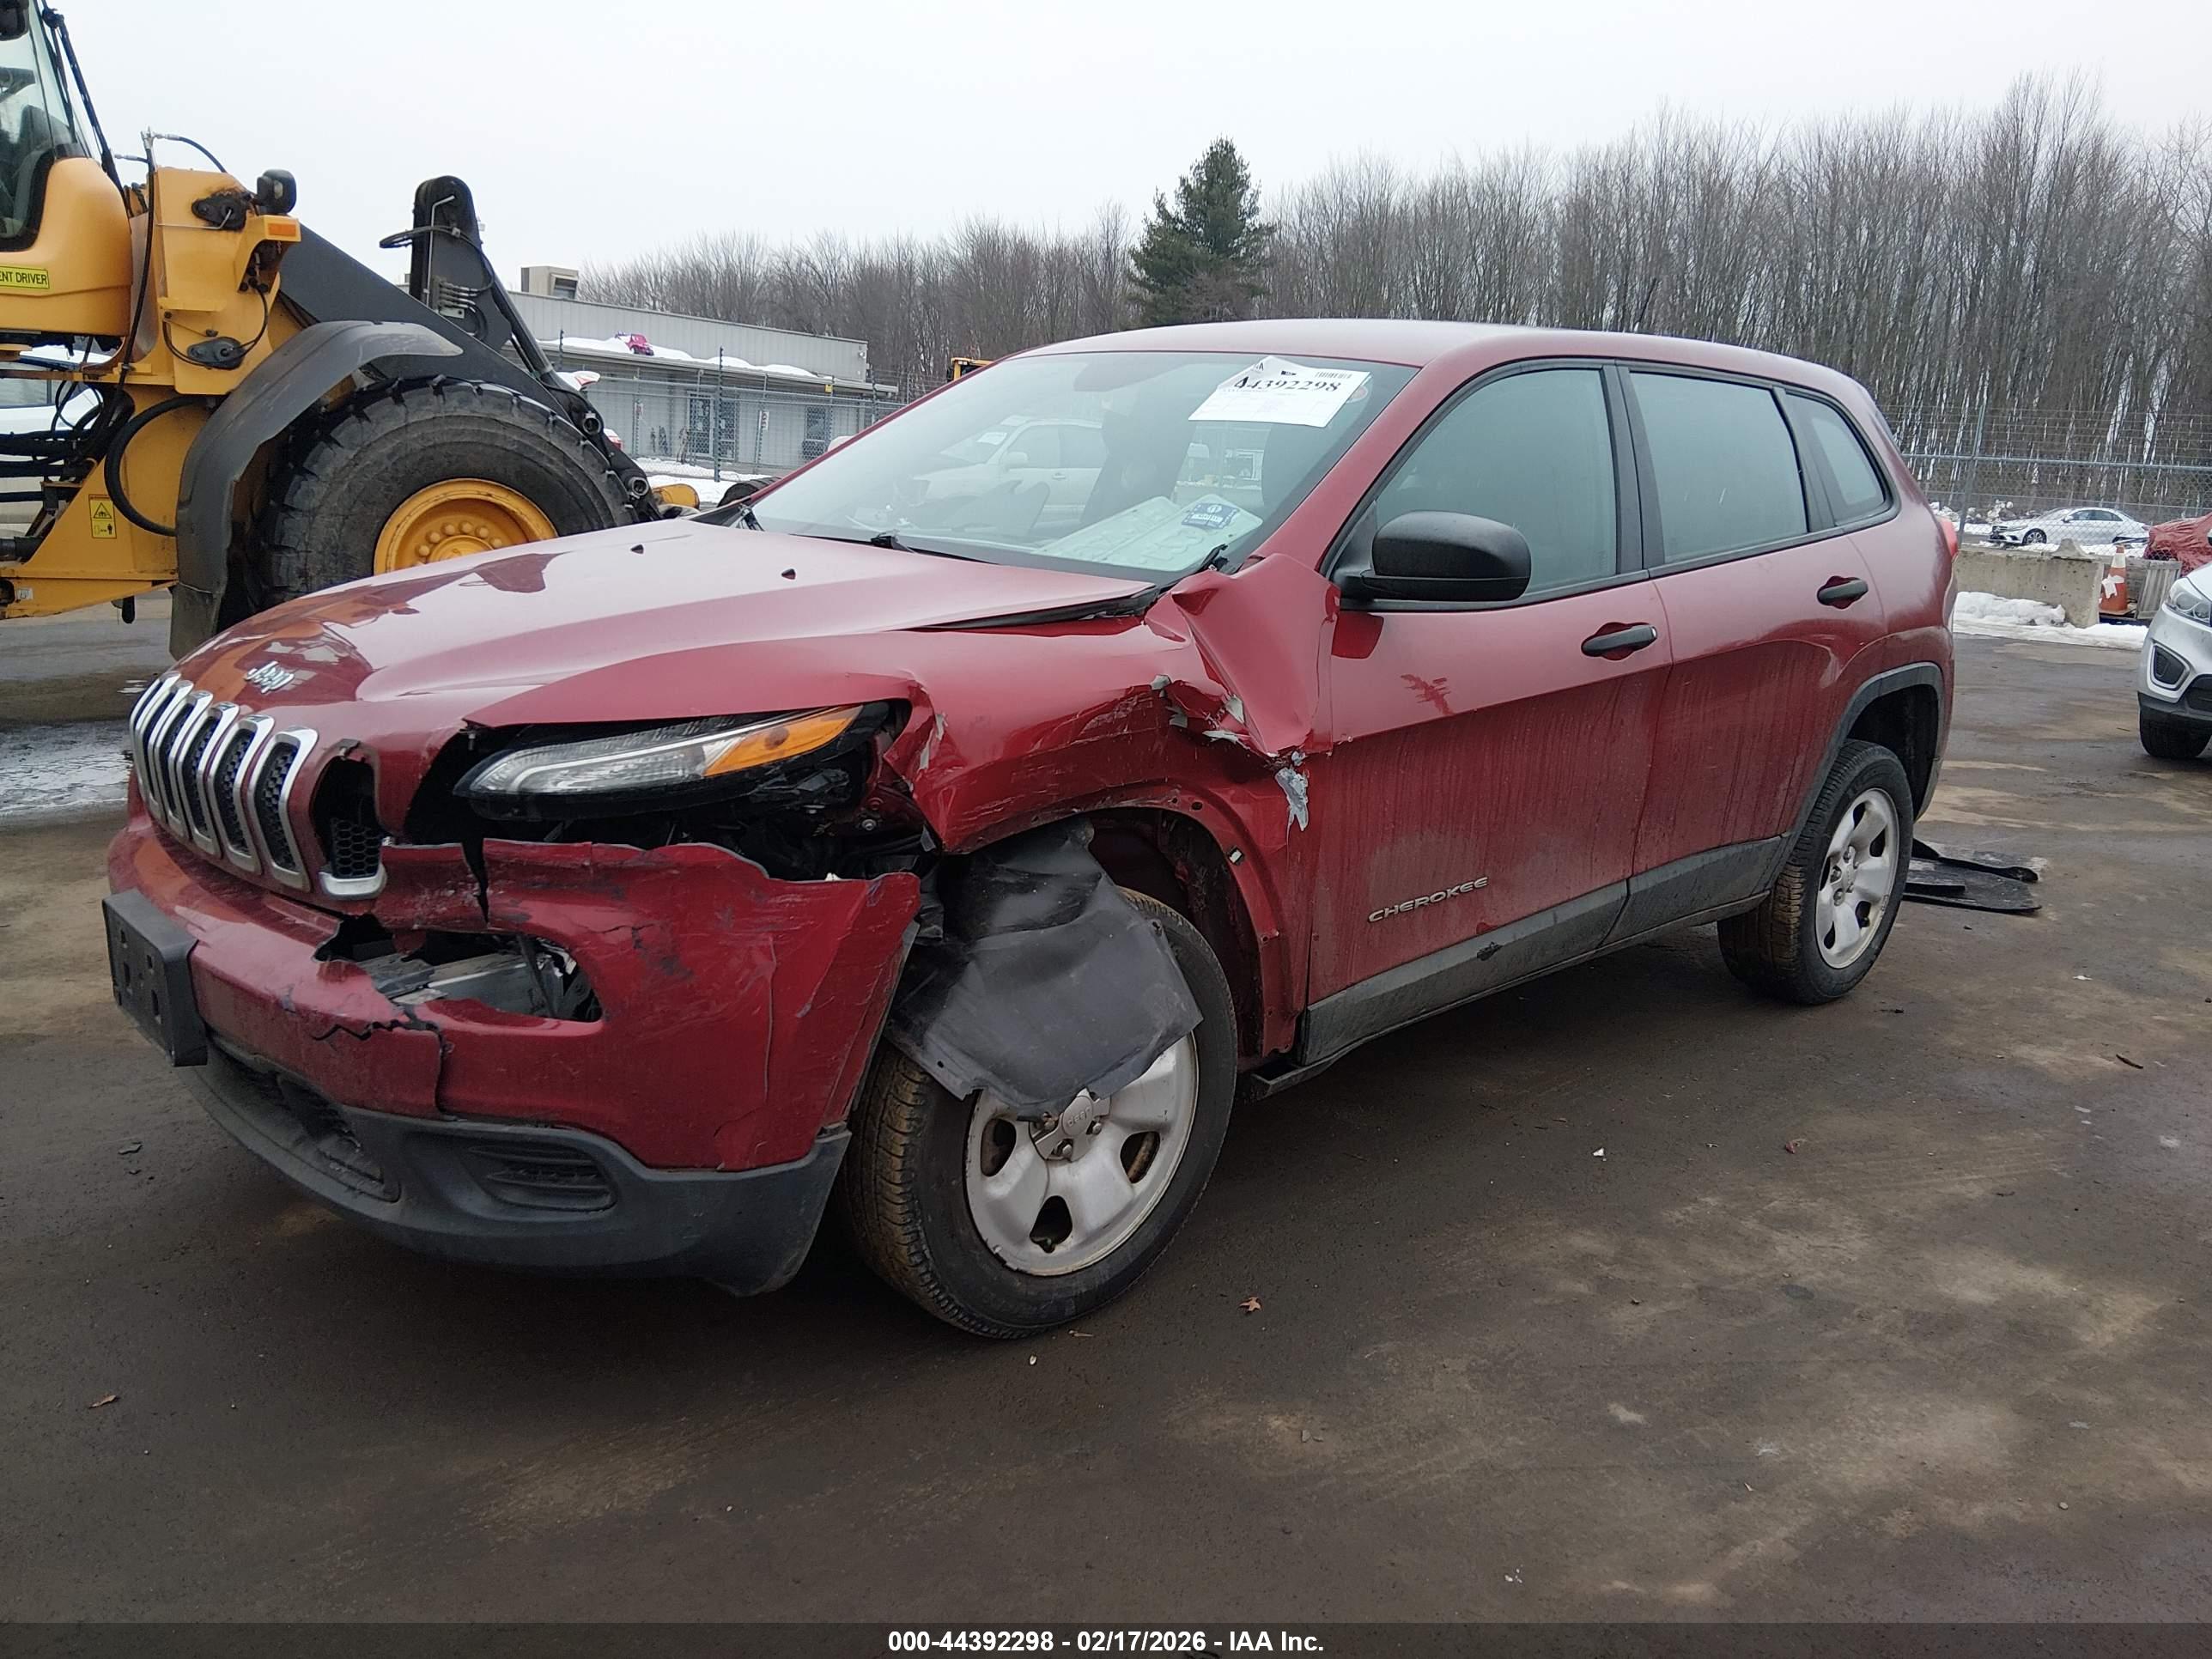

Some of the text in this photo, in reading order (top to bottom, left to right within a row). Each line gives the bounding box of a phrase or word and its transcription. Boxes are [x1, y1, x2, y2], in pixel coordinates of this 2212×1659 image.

[15, 271, 47, 285] DRIVER
[1234, 376, 1341, 392] 44392298
[1368, 877, 1488, 922] CHEROKEE
